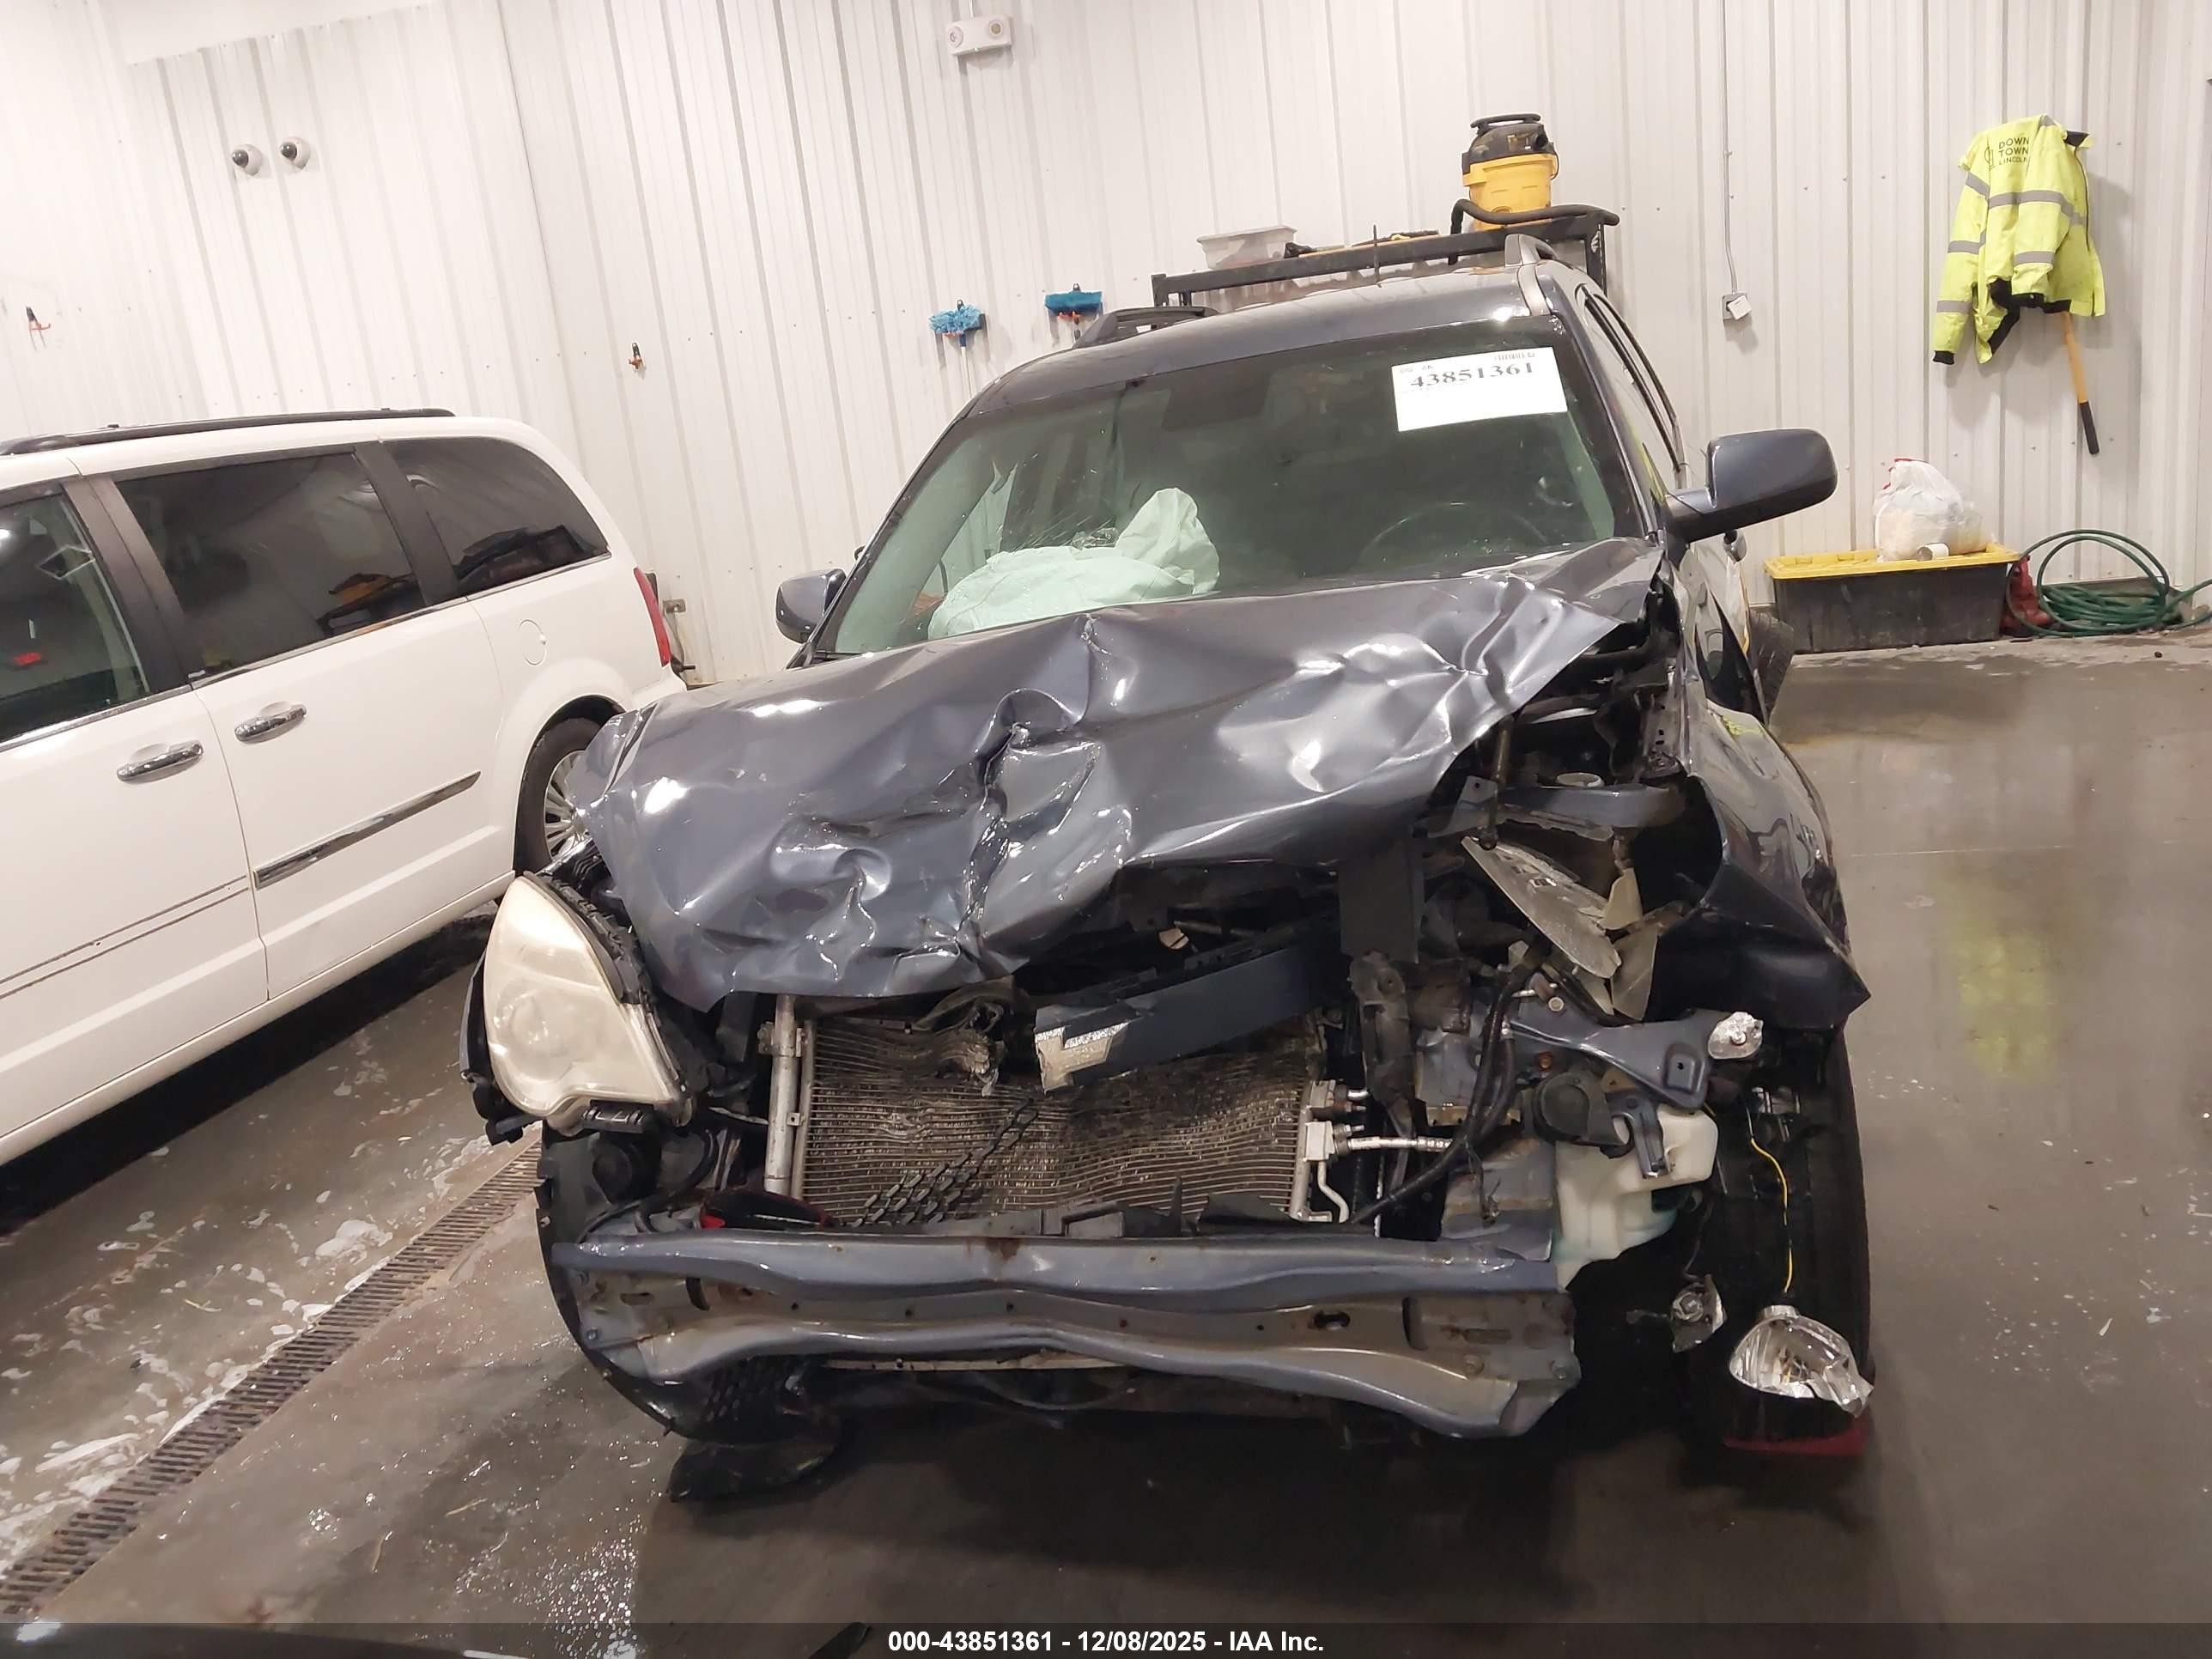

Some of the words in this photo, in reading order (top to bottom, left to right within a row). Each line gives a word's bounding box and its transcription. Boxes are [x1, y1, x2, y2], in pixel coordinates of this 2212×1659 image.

[1998, 137, 2030, 149] DOWN
[1998, 147, 2029, 158] TOWN
[1409, 362, 1533, 387] 43851361
